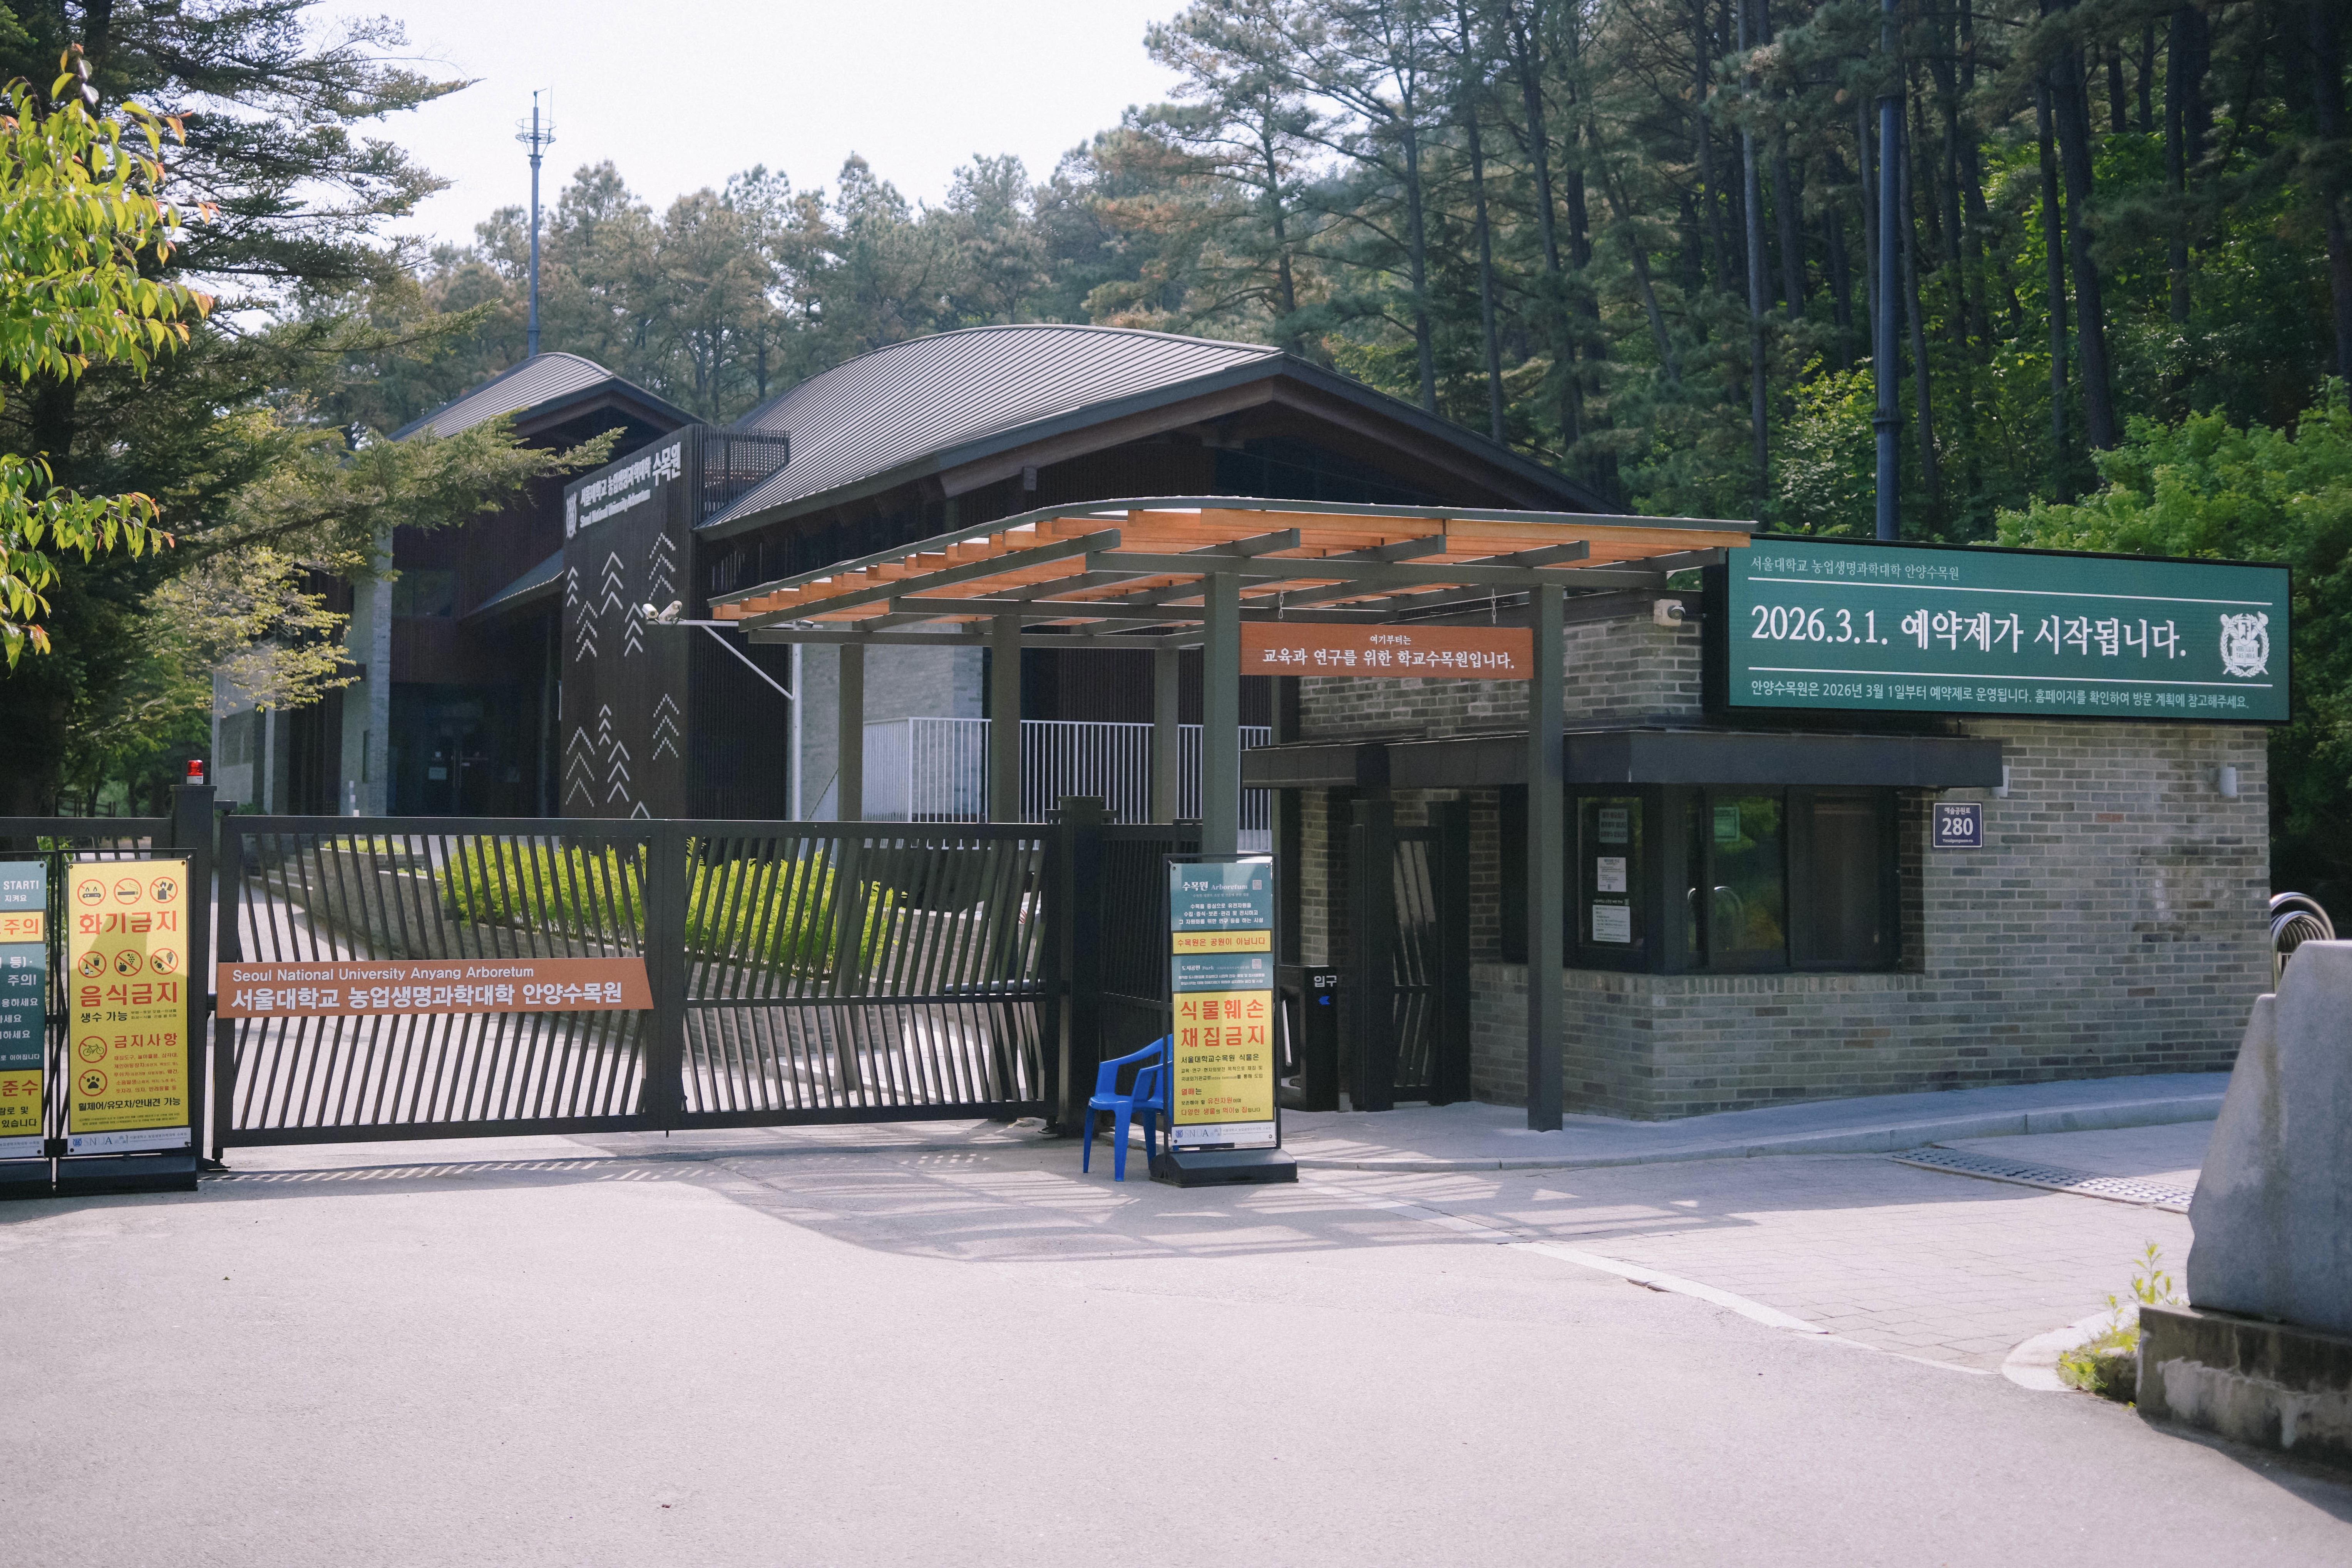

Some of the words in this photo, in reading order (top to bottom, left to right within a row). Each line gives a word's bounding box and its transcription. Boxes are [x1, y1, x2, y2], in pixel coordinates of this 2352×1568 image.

[580, 479, 608, 507] 서울대학교
[653, 442, 681, 486] 수목원
[1751, 556, 1808, 572] 서울대학교
[1811, 559, 1902, 578] 농업생명과학대학
[1905, 564, 1959, 581] 안양수목원
[1751, 605, 1888, 645] 2026.3.1.
[1901, 608, 2024, 654] 예약제가
[2034, 614, 2186, 659] 시작됩니다.
[1370, 634, 1412, 646] 여기부터는
[1262, 648, 1308, 665] 교육과
[1313, 649, 1358, 667] 연구를
[1363, 650, 1391, 667] 위한
[1398, 651, 1515, 670] 학교수목원입니다.
[1751, 680, 1820, 697] 안양수목원은
[1823, 683, 1863, 699] 2026년
[1866, 684, 1884, 699] 3월
[1888, 684, 1927, 701] 1일부터
[1930, 686, 1974, 702] 예약제로
[1976, 687, 2032, 703] 운영됩니다.
[2034, 688, 2086, 706] 홈페이지를
[2089, 690, 2129, 706] 확인하여
[2133, 691, 2153, 707] 방문
[2155, 692, 2185, 708] 계획에
[2188, 694, 2250, 709] 참고해주세요.
[1944, 807, 1971, 815] 예술공원로
[1942, 817, 1974, 835] 280
[1182, 881, 1209, 892] 수목원
[5, 894, 27, 902] 지켜요
[0, 919, 39, 935] 주의
[79, 910, 177, 935] 화기금지
[1177, 938, 1206, 947] 수목원은
[1210, 937, 1232, 946] 공원이
[1236, 937, 1266, 945] 아닙니다
[7, 974, 37, 986] 주의!
[233, 969, 272, 982] Seoul
[277, 968, 334, 981] National
[338, 967, 405, 981] University
[410, 967, 461, 981] Anyang
[465, 966, 534, 979] Arboretum
[1314, 975, 1337, 987] 입구
[80, 982, 177, 1007] 음식금지
[231, 987, 340, 1011] 서울대학교
[347, 983, 515, 1009] 농업생명과학대학
[522, 981, 622, 1005] 안양수목원
[80, 1012, 102, 1023] 생수
[106, 1011, 127, 1021] 가능
[1180, 999, 1264, 1021] 식물훼손
[0, 1030, 30, 1039] 하세요
[114, 1033, 177, 1048] 금지사항
[1181, 1025, 1264, 1047] 채집금지
[1181, 1054, 1235, 1064] 서울대학교수목원
[1239, 1053, 1259, 1061] 식물은
[2, 1079, 38, 1097] 준수
[78, 1098, 161, 1112] 휠체어/유모차/안내견
[164, 1097, 181, 1106] 가능
[1207, 1096, 1242, 1104] 유전자원이며
[20, 1106, 28, 1115] 및
[2, 1118, 37, 1128] 있습니다
